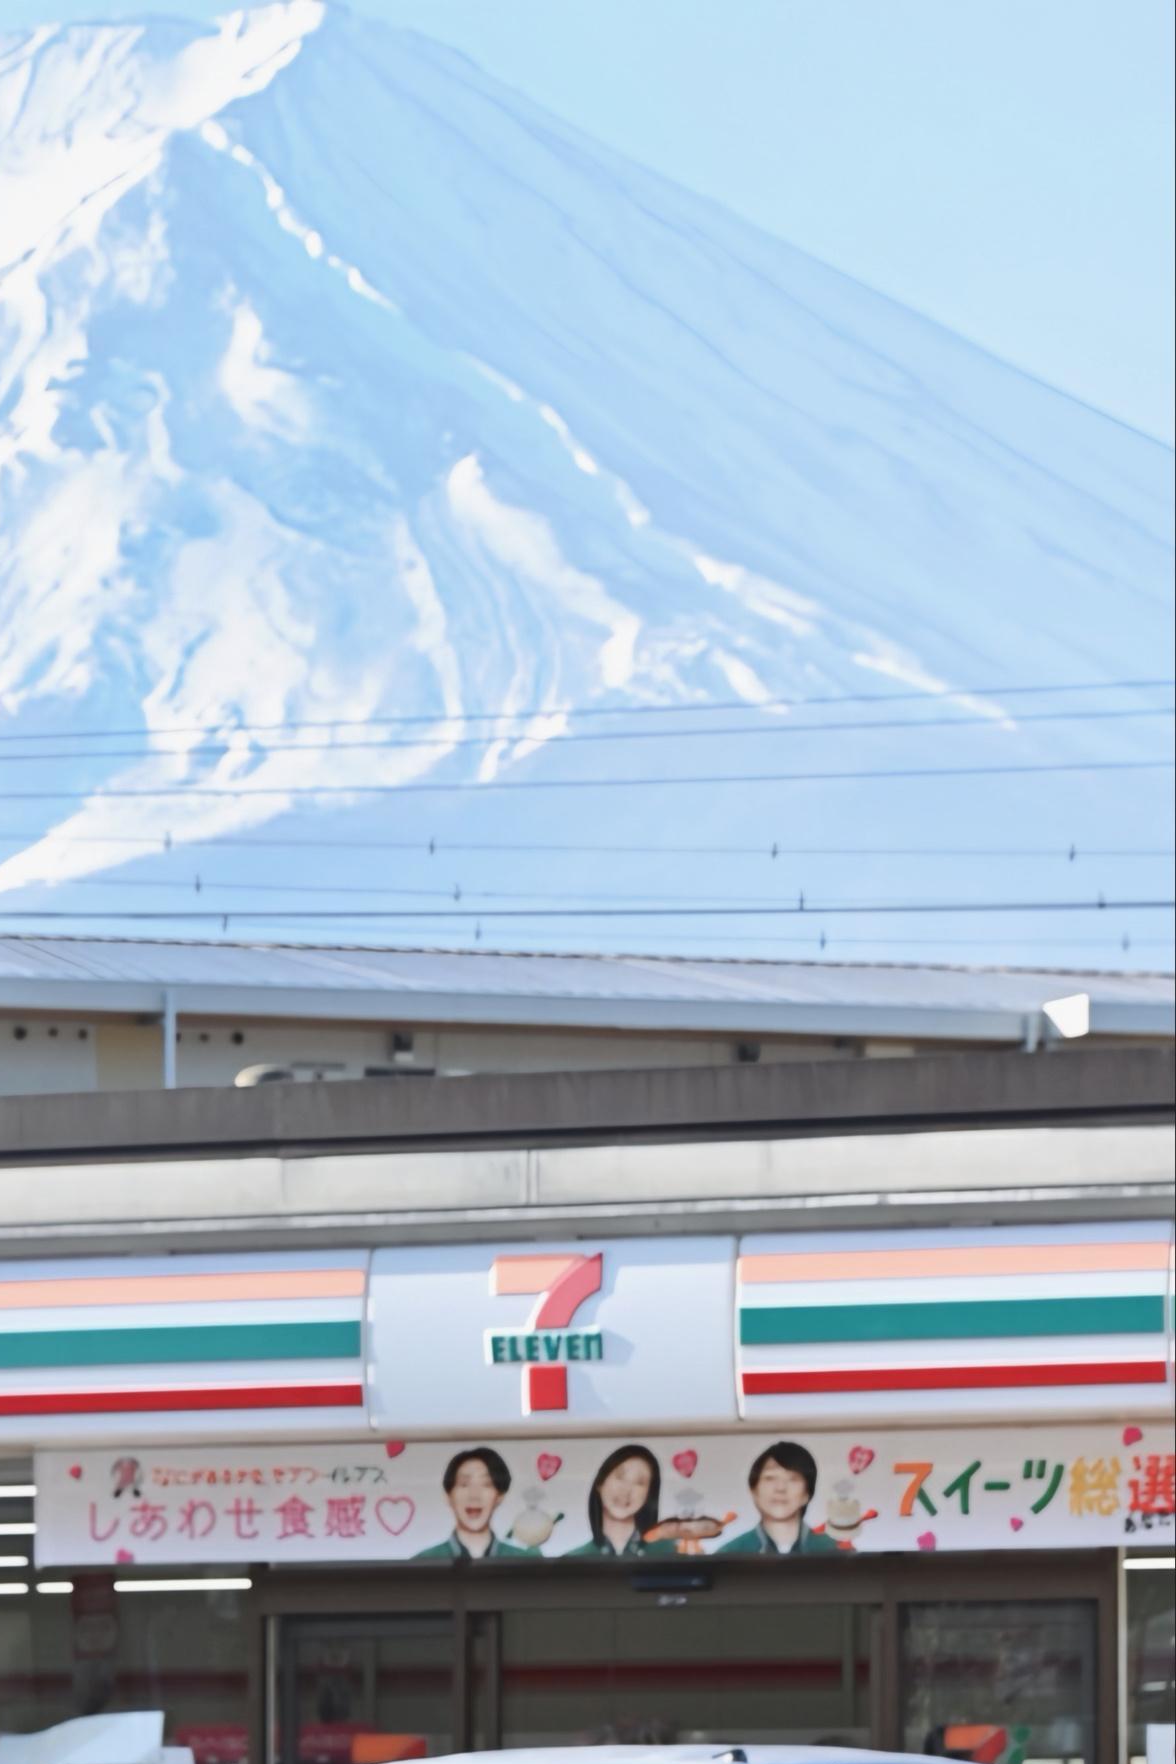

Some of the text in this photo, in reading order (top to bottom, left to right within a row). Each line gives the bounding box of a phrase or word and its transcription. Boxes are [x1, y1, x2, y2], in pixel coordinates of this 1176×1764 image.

[88, 1494, 367, 1543] しあわせ食感
